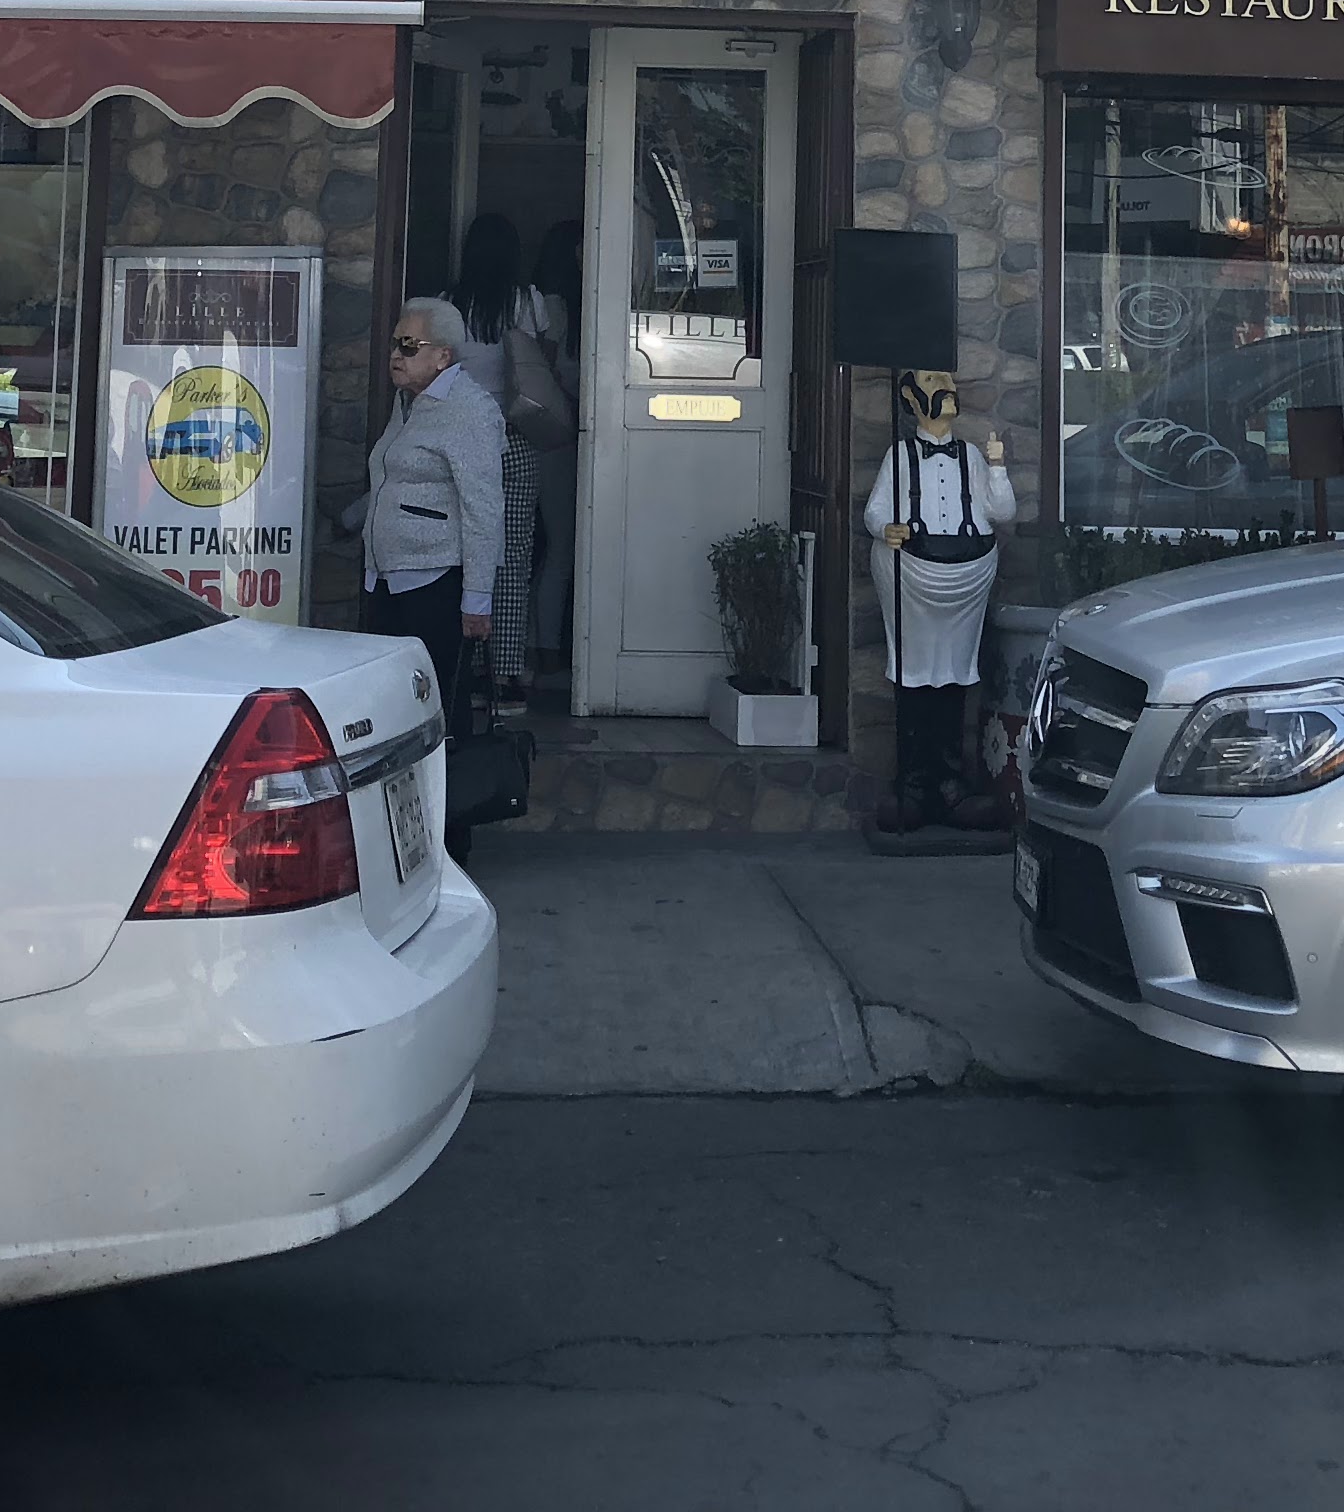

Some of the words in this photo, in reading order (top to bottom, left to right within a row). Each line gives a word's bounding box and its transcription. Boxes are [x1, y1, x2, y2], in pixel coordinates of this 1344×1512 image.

[706, 259, 730, 269] VISA
[665, 399, 726, 418] EMPUJE
[114, 525, 183, 554] VALET
[190, 526, 292, 555] PARKING
